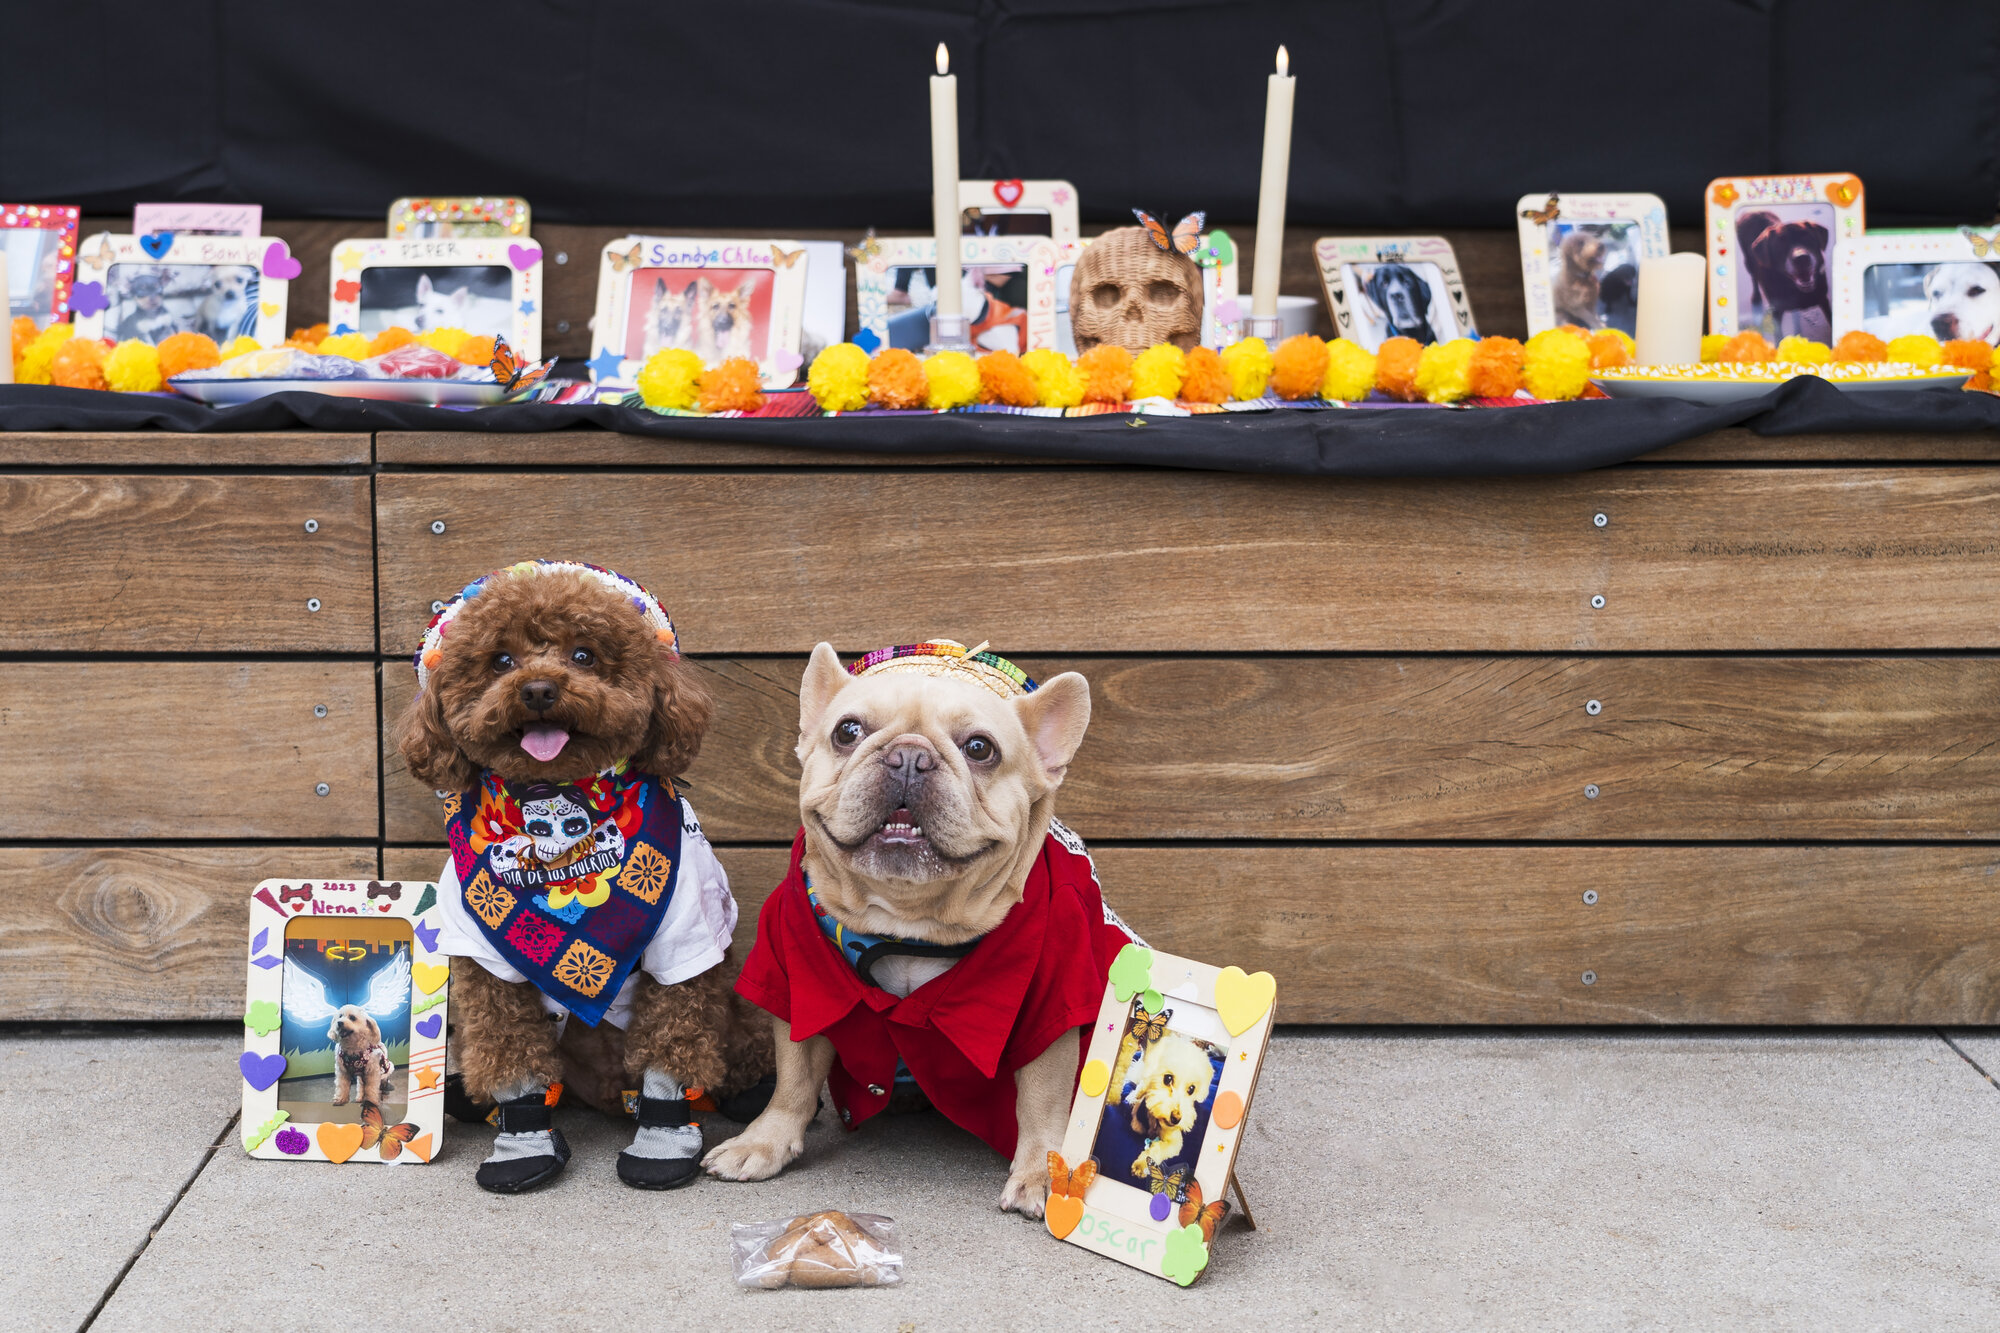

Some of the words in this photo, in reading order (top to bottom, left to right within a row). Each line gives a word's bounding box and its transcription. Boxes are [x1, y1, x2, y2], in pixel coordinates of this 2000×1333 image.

[401, 242, 460, 259] PIPER
[650, 244, 709, 268] Sandy
[722, 246, 771, 264] Chloe
[502, 872, 528, 888] DIA
[528, 868, 546, 884] DE
[547, 867, 567, 881] LOS
[569, 850, 617, 877] MUERTOS
[323, 881, 356, 892] 2023
[312, 899, 358, 914] Nena
